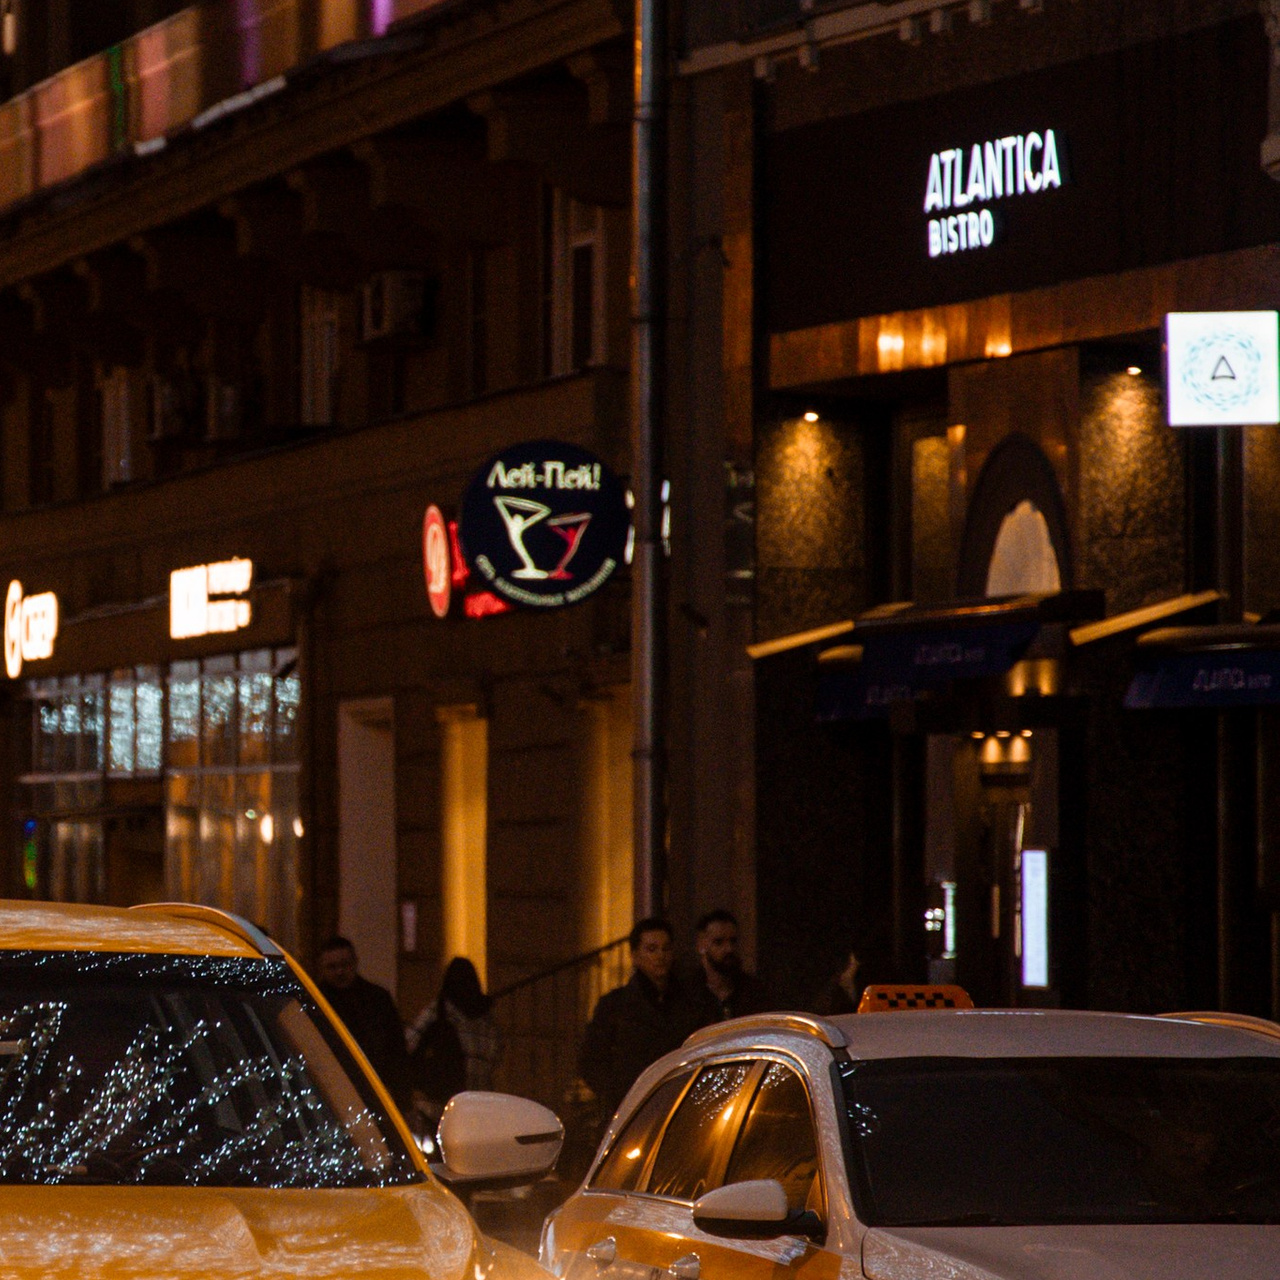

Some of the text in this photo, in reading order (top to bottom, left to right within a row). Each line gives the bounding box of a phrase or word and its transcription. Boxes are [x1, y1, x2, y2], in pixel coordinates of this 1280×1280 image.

[924, 129, 1061, 213] ATLANTICA
[928, 209, 994, 258] BISTRO
[487, 460, 601, 491] Лей-Пей!
